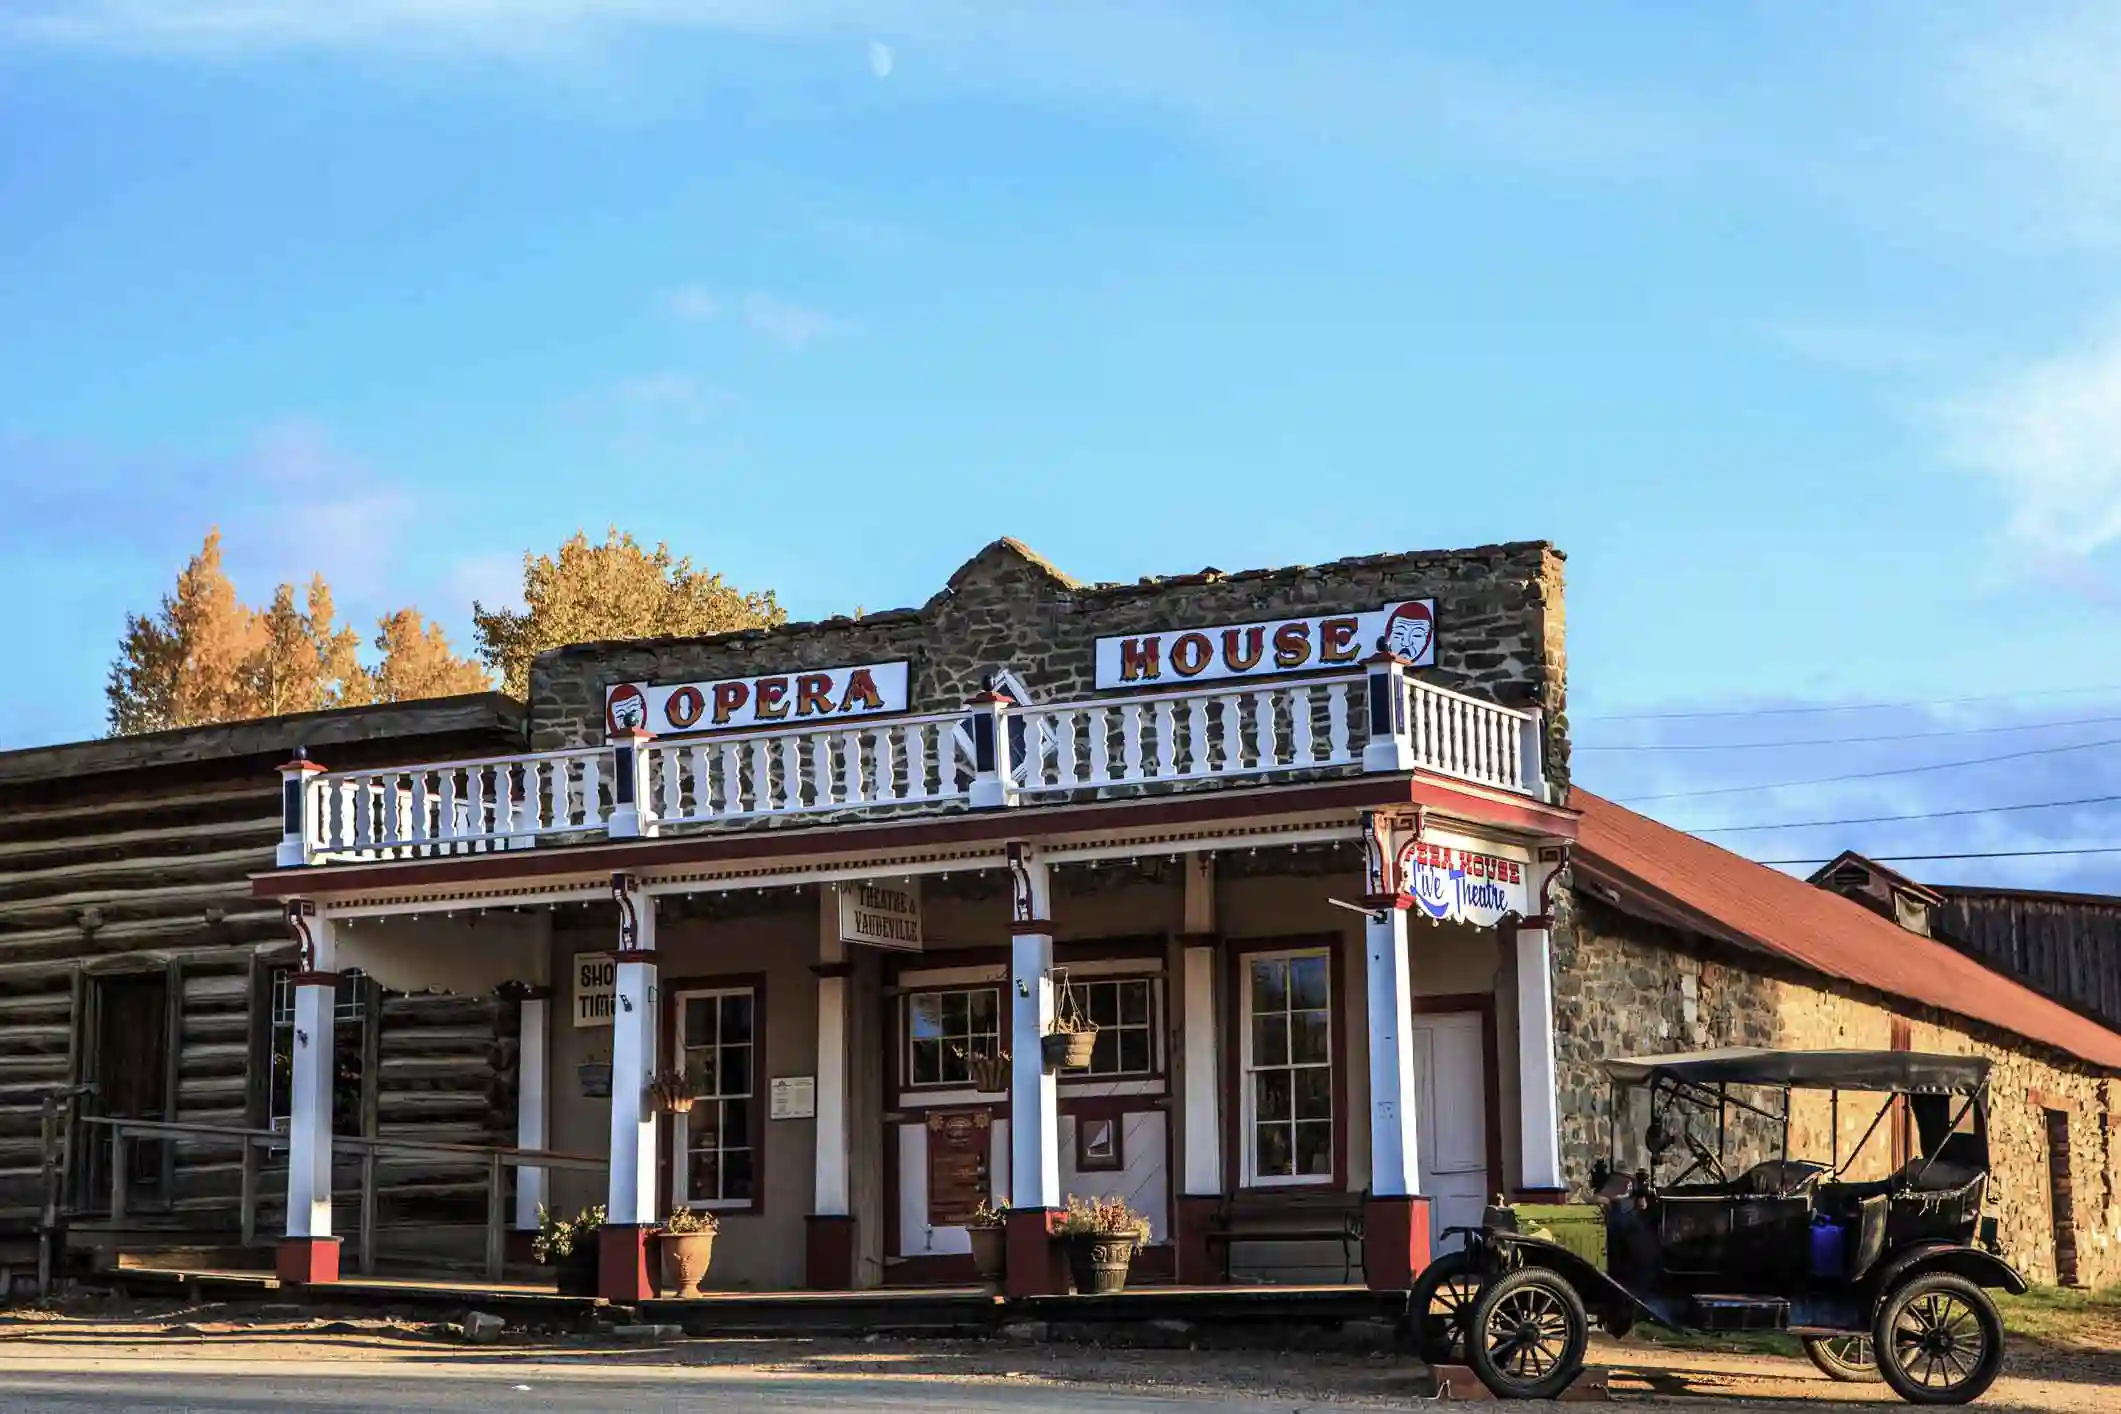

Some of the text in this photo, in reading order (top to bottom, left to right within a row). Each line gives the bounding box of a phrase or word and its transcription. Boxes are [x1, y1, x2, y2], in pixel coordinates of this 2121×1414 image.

[1119, 617, 1361, 681] HOUSE
[664, 669, 885, 728] OPERA
[1405, 843, 1520, 884] PERA HOUSE
[859, 884, 908, 914] THEATRE
[1410, 859, 1508, 918] Live Theatre
[854, 909, 918, 942] VAUDEVILLE
[581, 963, 615, 987] SHO
[579, 993, 616, 1018] TIM
